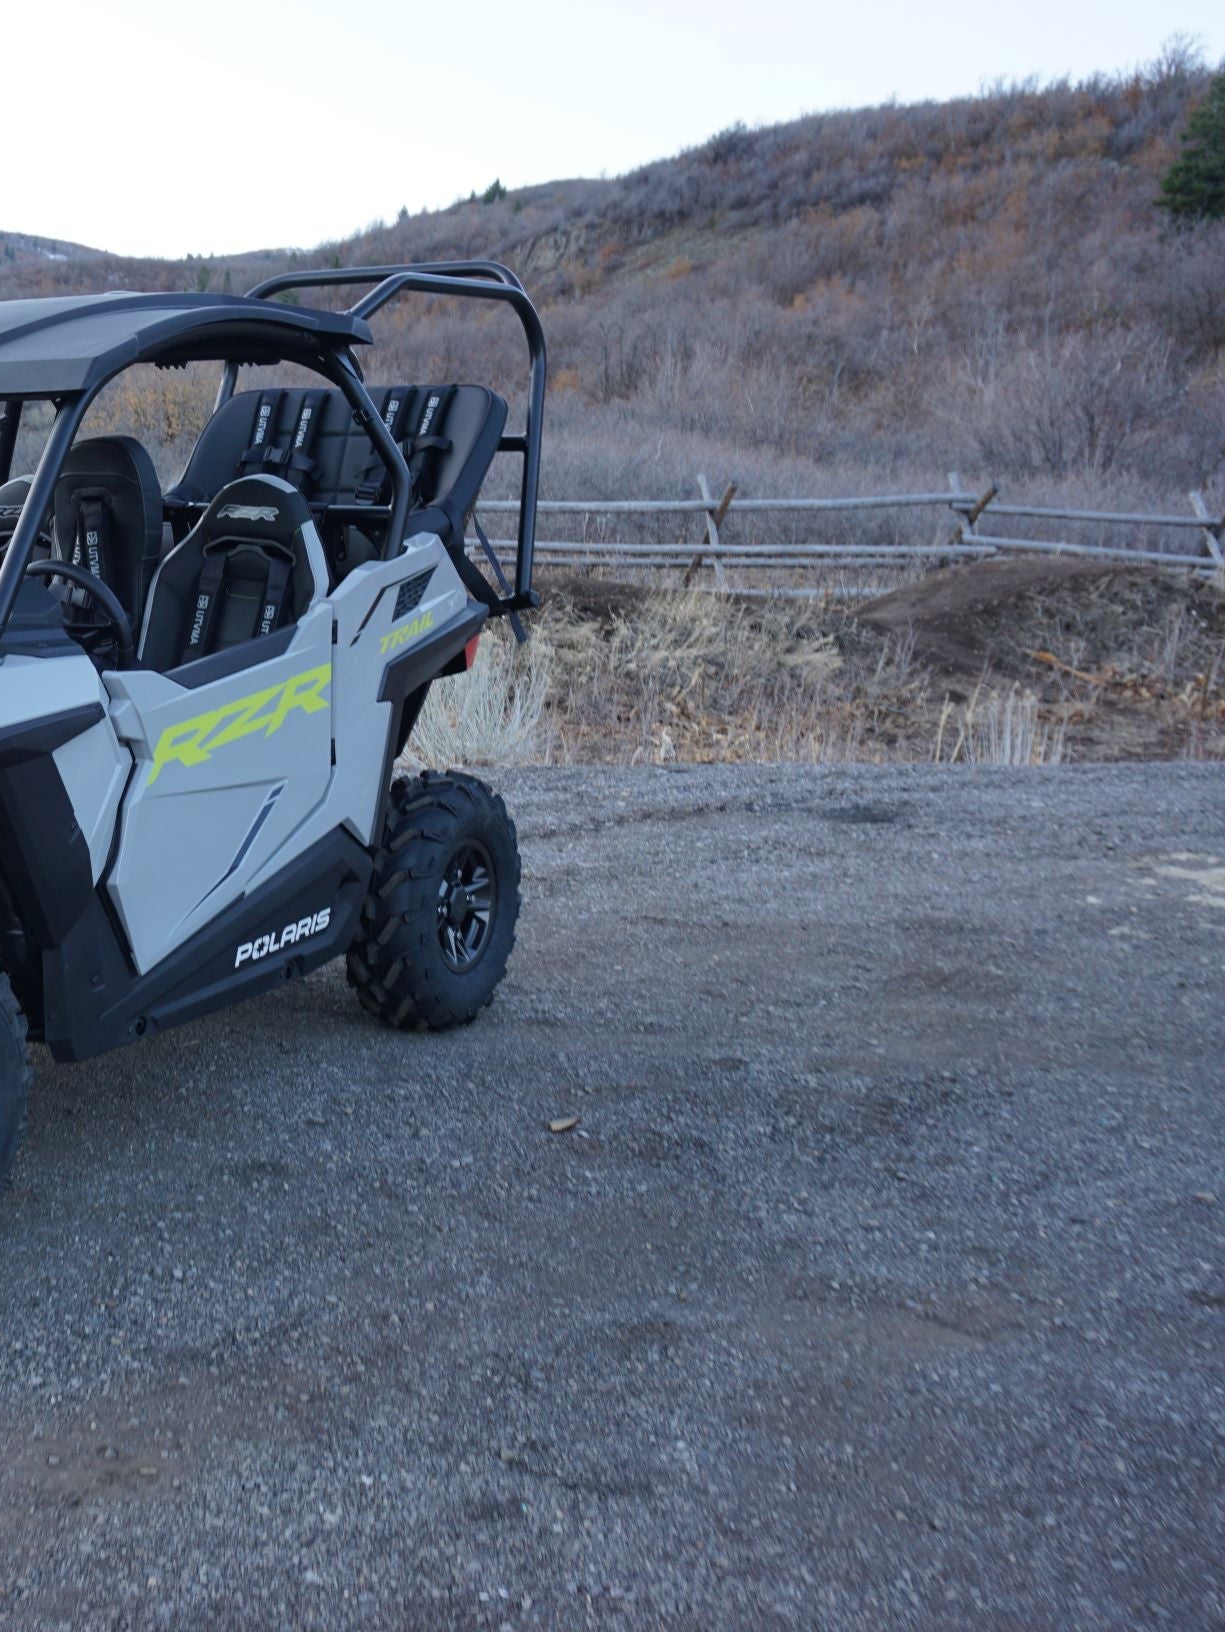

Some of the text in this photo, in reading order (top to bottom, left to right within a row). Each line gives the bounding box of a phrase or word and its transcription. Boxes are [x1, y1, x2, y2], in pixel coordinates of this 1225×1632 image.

[255, 417, 267, 445] UTVMA
[295, 420, 308, 448] UTVMA
[190, 610, 205, 645] UTVMA
[380, 608, 434, 655] TRAIL
[146, 661, 332, 787] RZR
[235, 906, 331, 969] POLARIS
